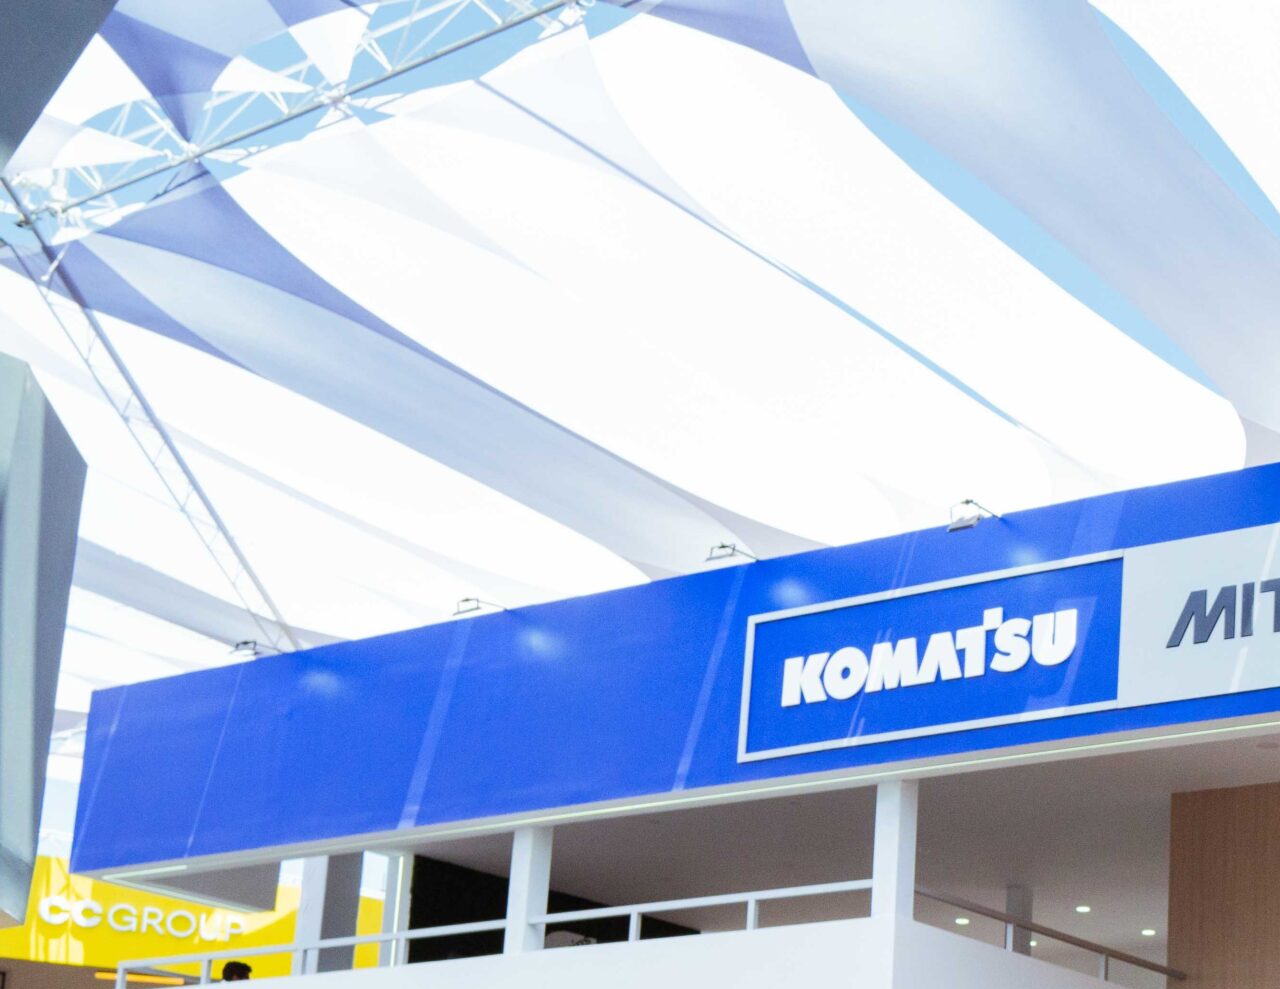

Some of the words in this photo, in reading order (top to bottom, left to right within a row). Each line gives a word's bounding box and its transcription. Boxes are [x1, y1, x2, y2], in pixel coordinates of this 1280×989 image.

[781, 607, 1078, 707] KOMATSU
[38, 895, 103, 927] CC
[107, 903, 247, 942] GROUP
